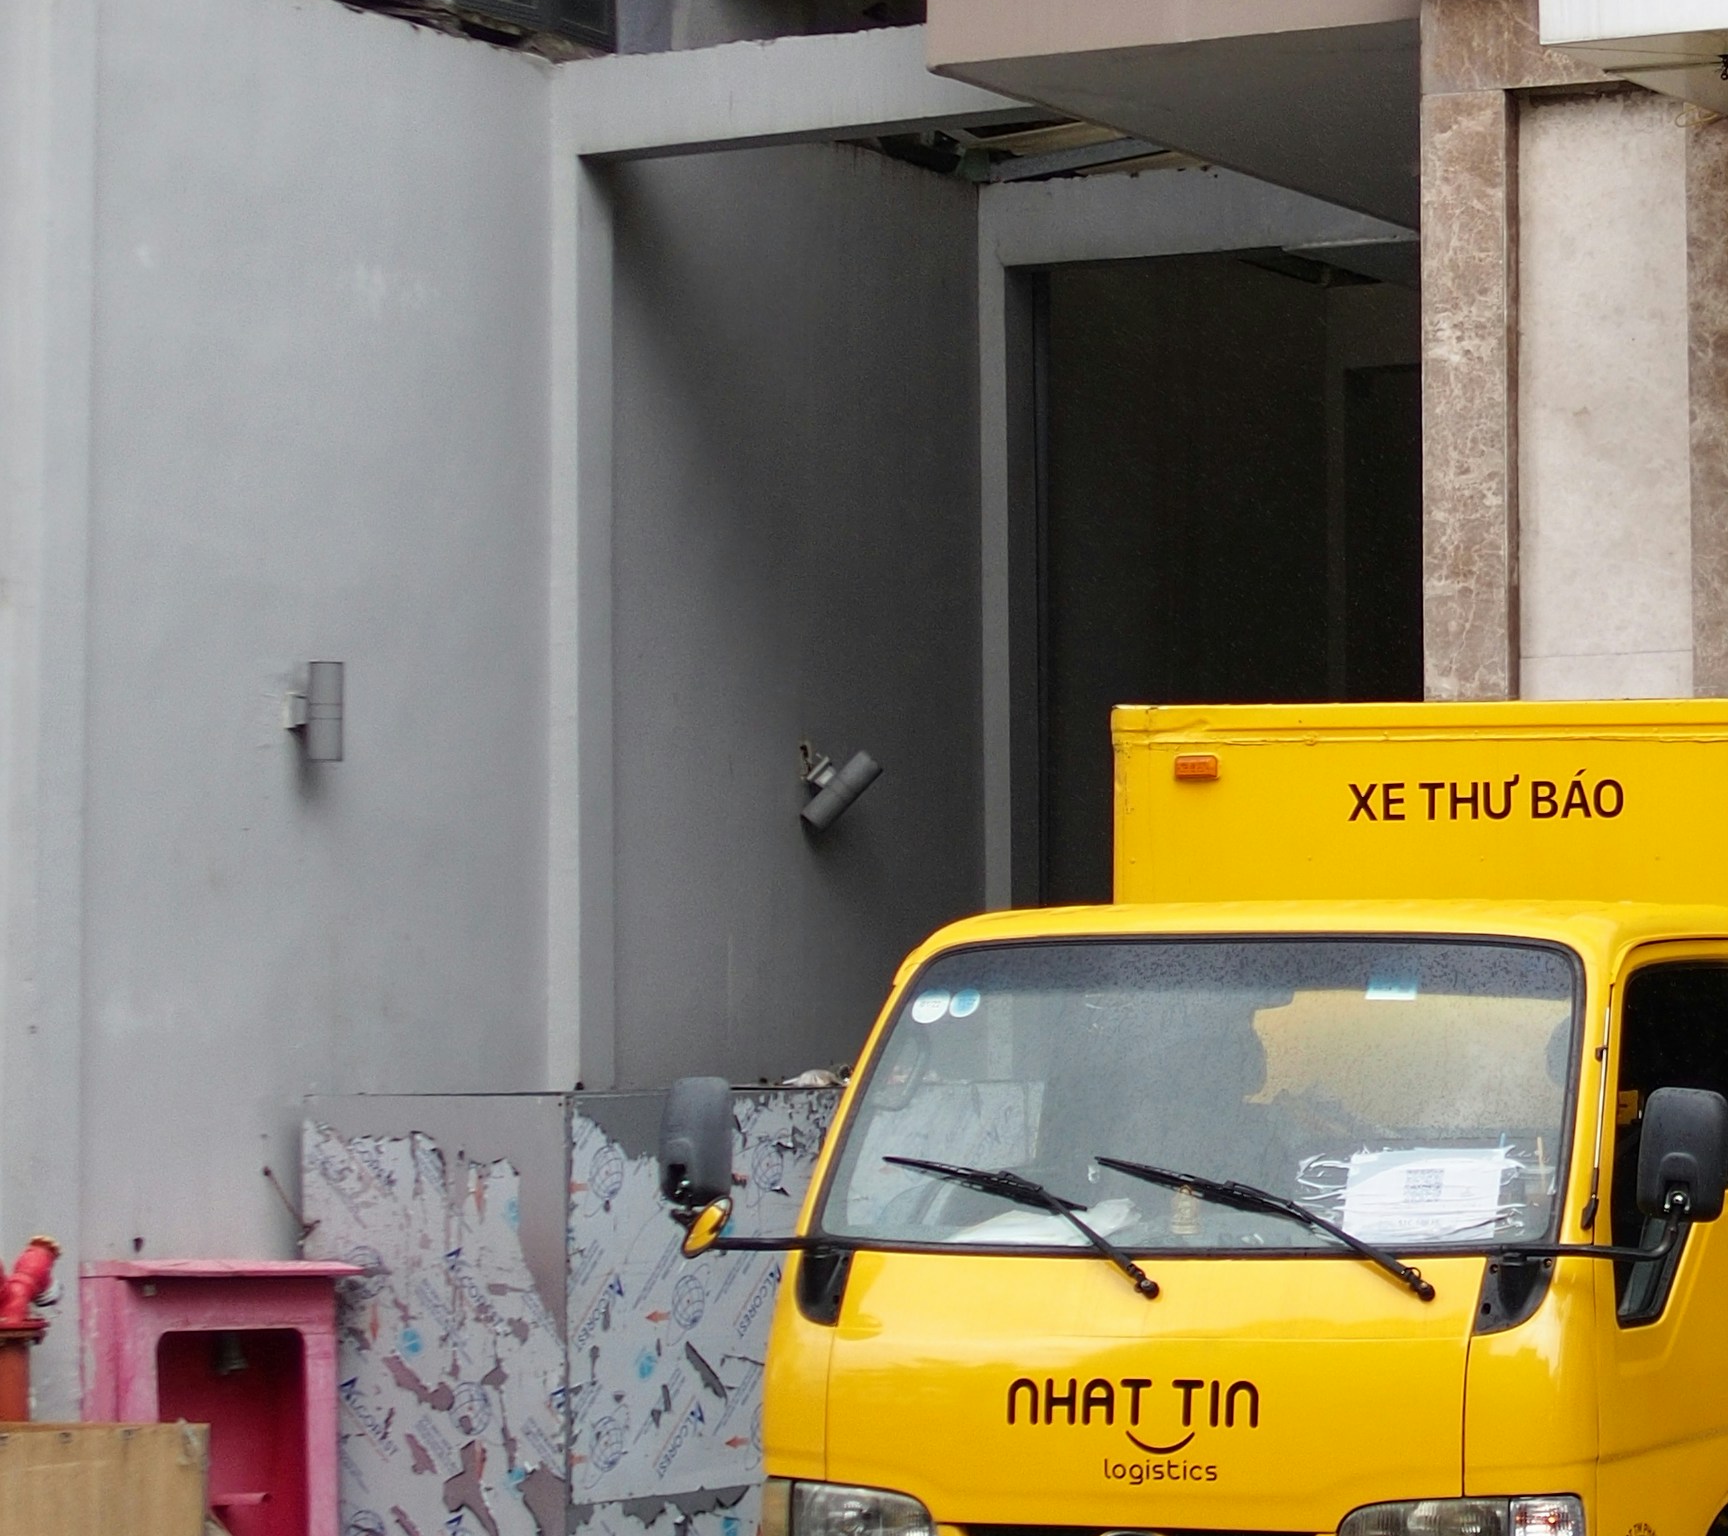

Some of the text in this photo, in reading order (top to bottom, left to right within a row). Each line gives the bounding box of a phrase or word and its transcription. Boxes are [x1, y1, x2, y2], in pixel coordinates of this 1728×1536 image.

[1348, 768, 1625, 822] XE THƯ BÁO
[1103, 1458, 1218, 1485] logistics
